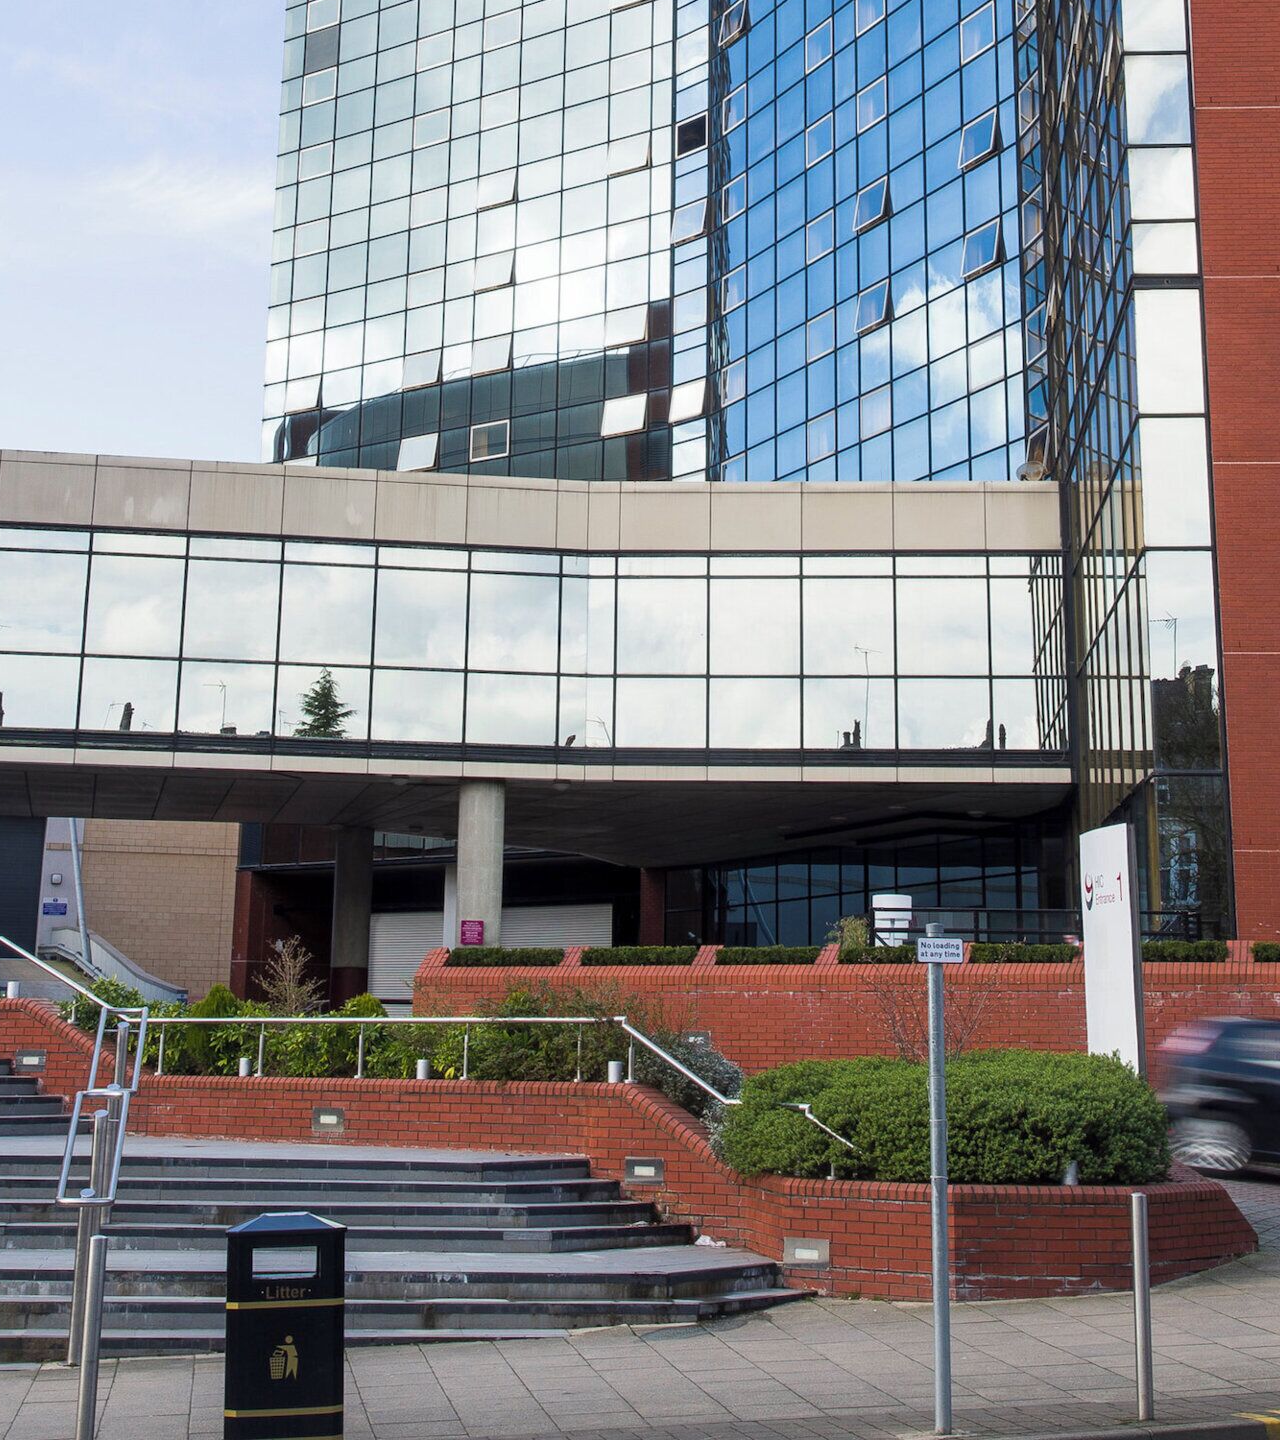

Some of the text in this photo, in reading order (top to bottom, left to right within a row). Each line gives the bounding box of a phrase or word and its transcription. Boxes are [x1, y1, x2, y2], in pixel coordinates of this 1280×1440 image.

[1096, 893, 1116, 905] Entrance
[933, 942, 960, 950] loading
[266, 1286, 306, 1299] Litter
